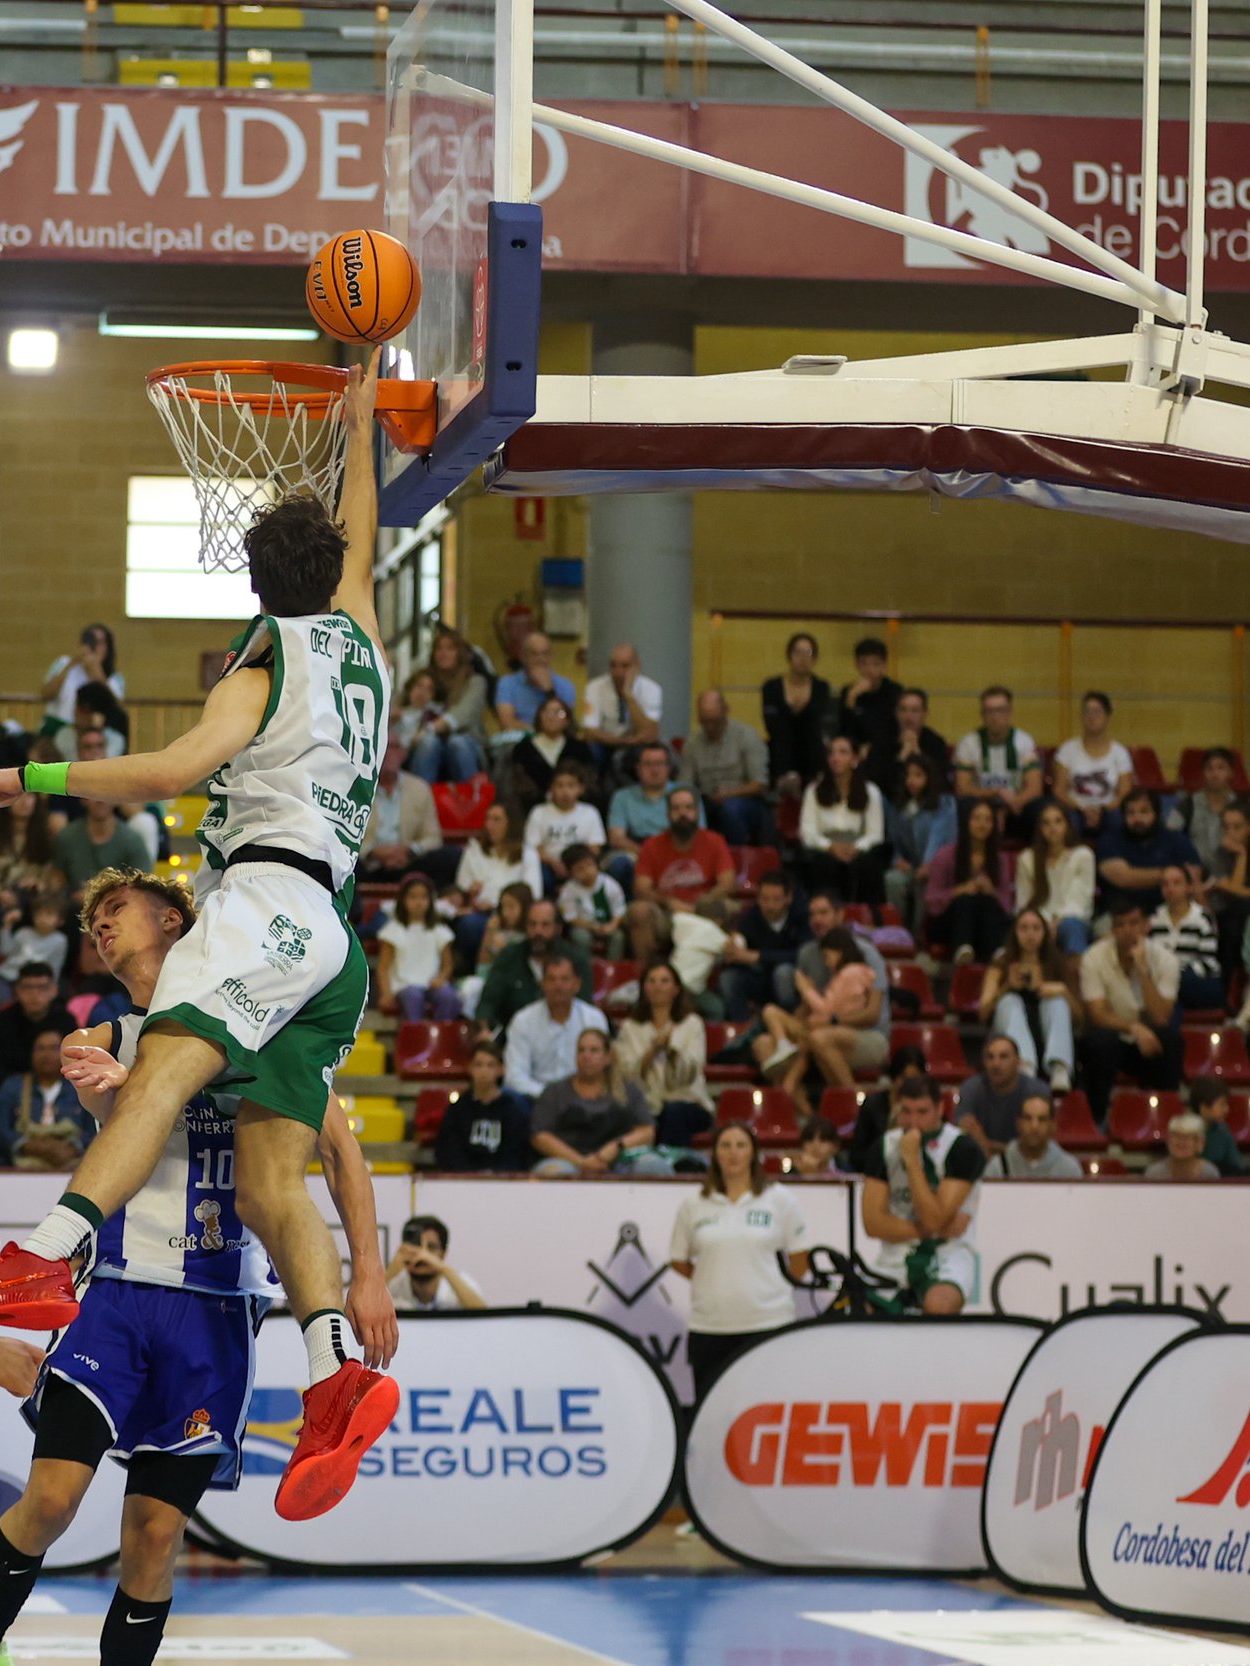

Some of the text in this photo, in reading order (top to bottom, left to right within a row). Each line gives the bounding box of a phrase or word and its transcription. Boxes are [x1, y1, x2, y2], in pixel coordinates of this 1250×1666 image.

[40, 218, 203, 256] Municipal
[210, 222, 254, 252] de
[342, 237, 364, 309] Wilson
[311, 628, 333, 659] DEL
[221, 978, 271, 1022] efficold
[195, 1149, 236, 1190] 10
[168, 1234, 197, 1250] cat
[72, 1353, 100, 1371] vive
[386, 1388, 603, 1434] EALE
[1113, 1521, 1212, 1569] Cordobesa
[1215, 1530, 1248, 1574] del
